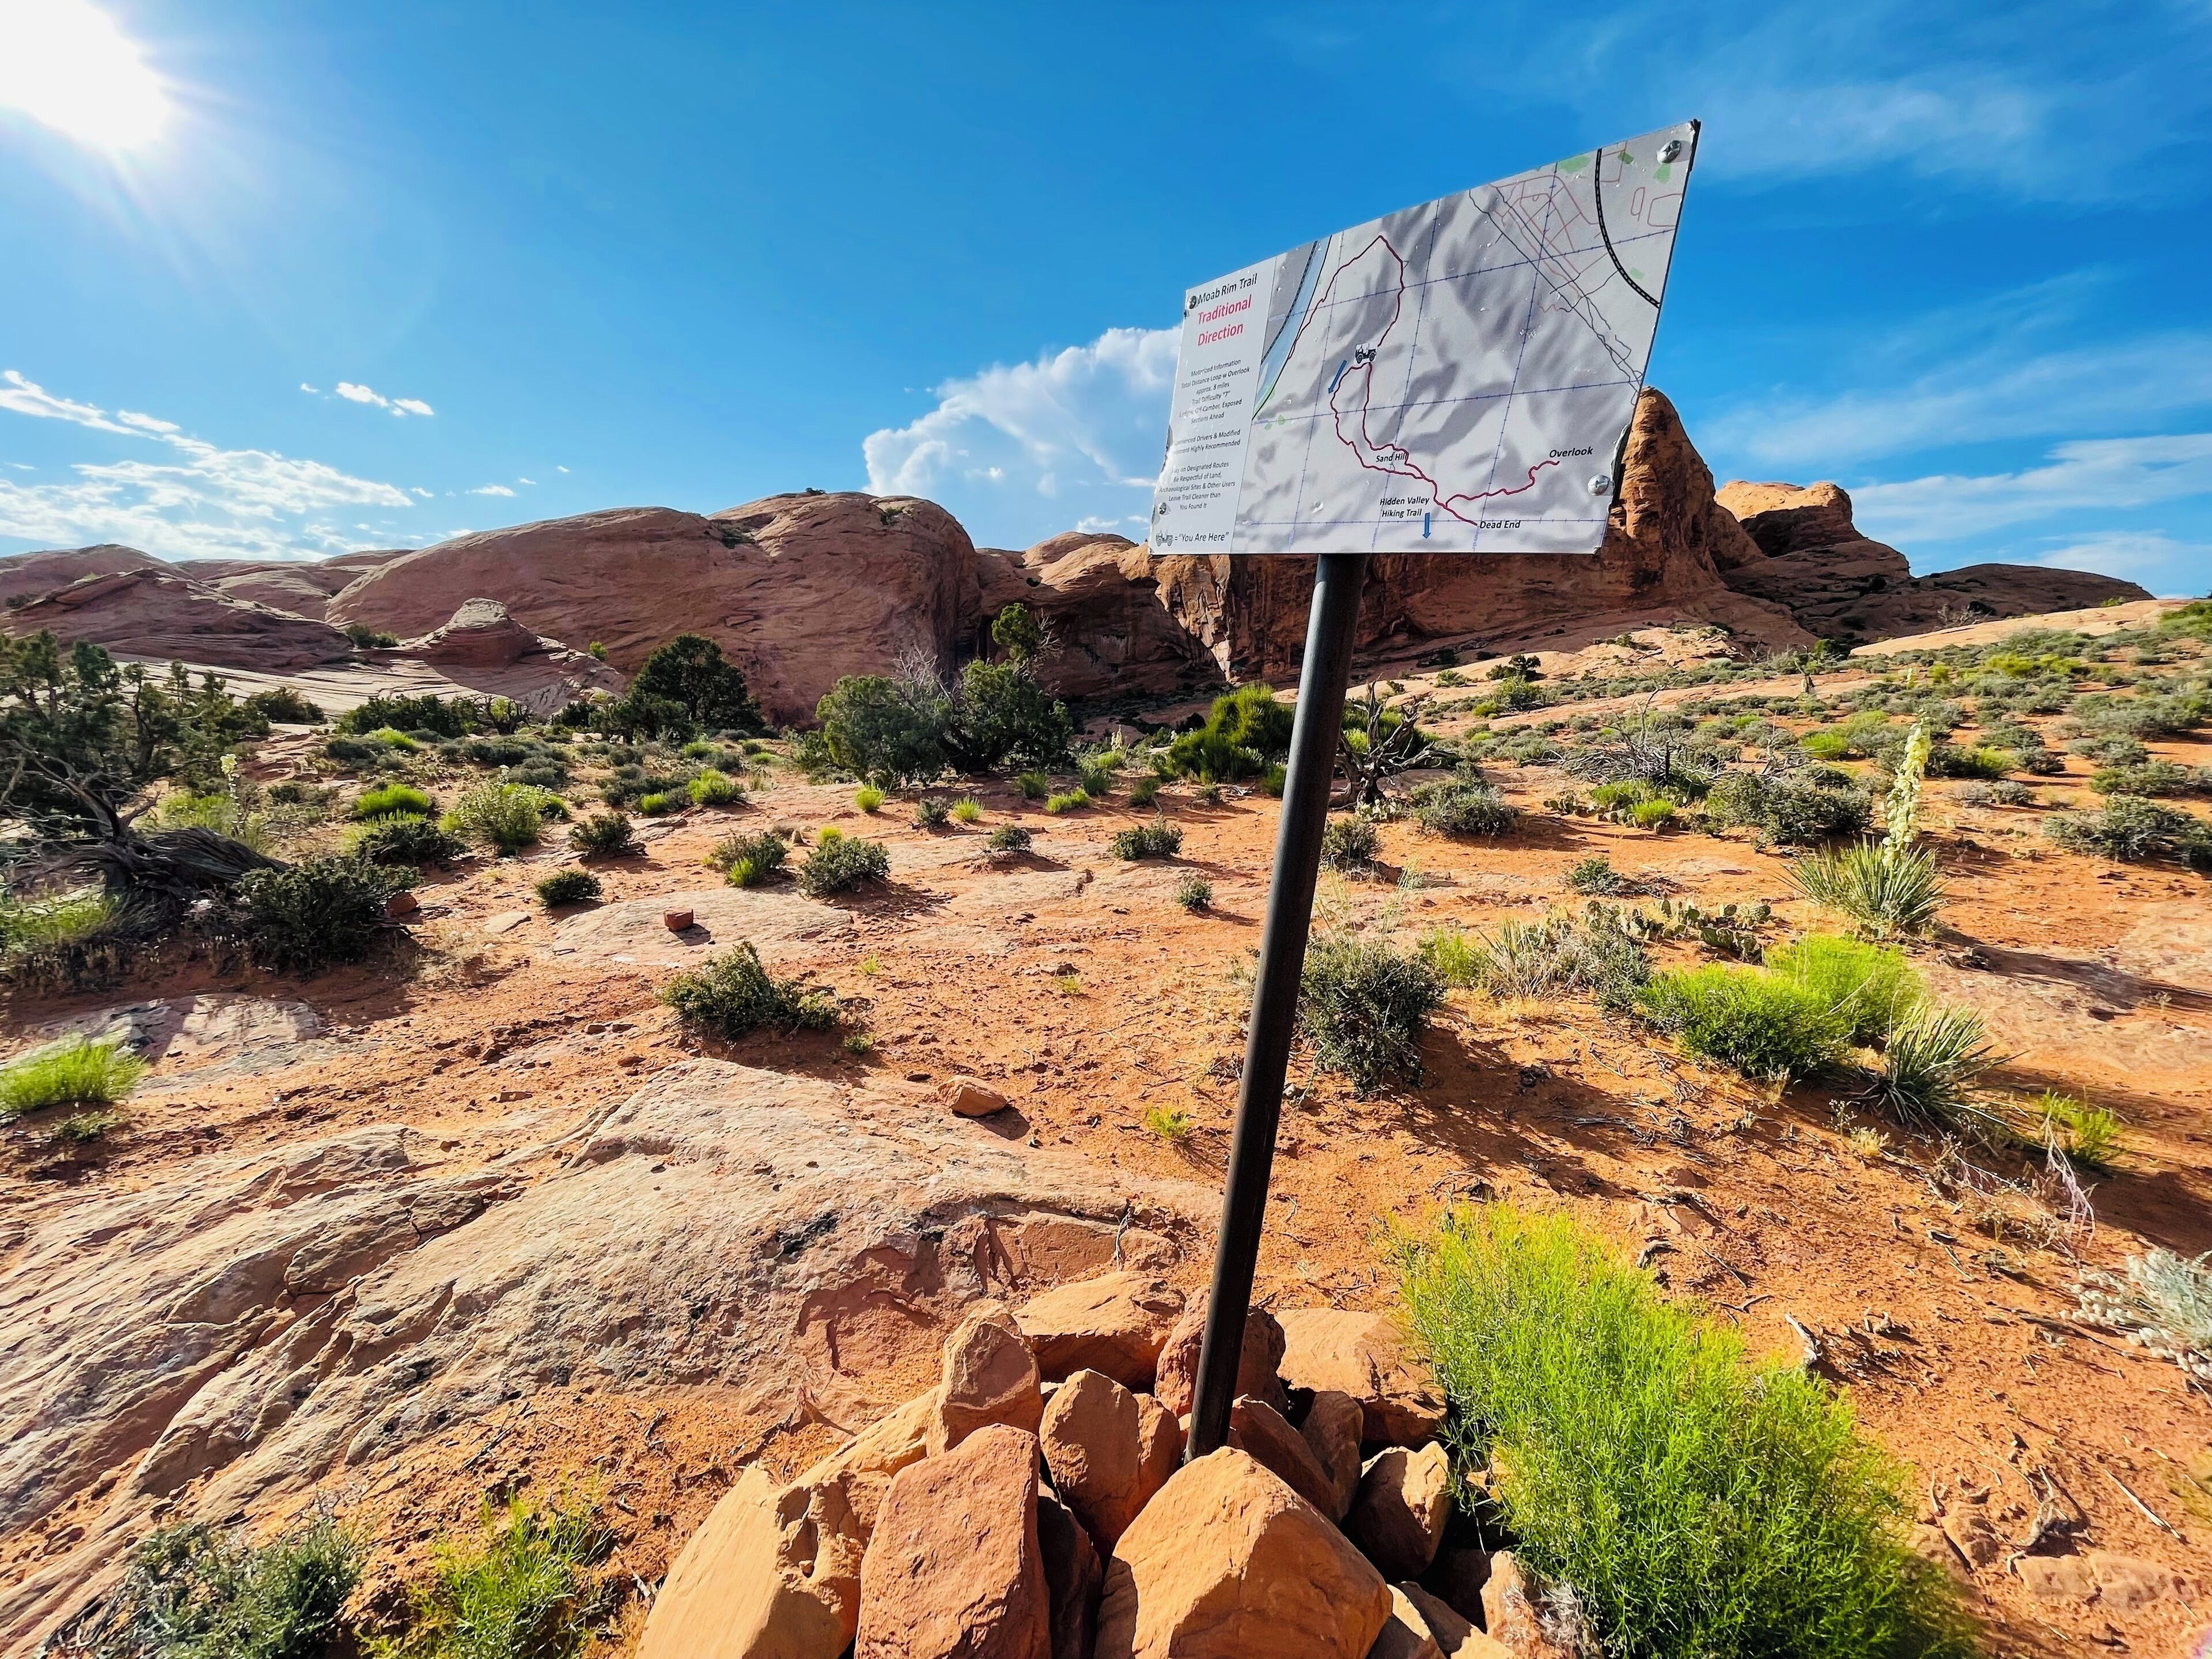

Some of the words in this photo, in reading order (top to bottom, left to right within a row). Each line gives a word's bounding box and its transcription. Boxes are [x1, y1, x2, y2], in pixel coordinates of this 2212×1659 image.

[1198, 288, 1219, 304] Moab
[1221, 284, 1236, 296] Rim
[1240, 273, 1257, 289] Trail
[1198, 294, 1252, 324] Traditional
[1198, 323, 1243, 346] Direction
[1191, 366, 1213, 377] Motorized
[1214, 359, 1241, 370] Information
[1191, 377, 1210, 386] Distance
[1210, 374, 1222, 382] Loop
[1228, 366, 1250, 377] Overlook
[1201, 393, 1221, 403] Difficulty
[1222, 398, 1242, 408] Exposed
[1191, 416, 1209, 424] Sections
[1196, 433, 1213, 442] Drivers
[1218, 429, 1241, 438] Modified
[1190, 444, 1205, 453] Highly
[1205, 439, 1240, 450] Recommended
[1550, 446, 1593, 457] Overlook
[1376, 453, 1393, 463] Sand
[1187, 463, 1213, 472] Designated
[1180, 474, 1203, 482] Respectful
[1159, 484, 1190, 493] Archaeological
[1380, 497, 1405, 506] Hidden
[1407, 496, 1430, 505] Valley
[1381, 509, 1405, 518] Hiking
[1407, 508, 1422, 516] Trail
[1479, 520, 1502, 529] Dead
[1503, 520, 1521, 528] End
[1194, 533, 1207, 541] Are
